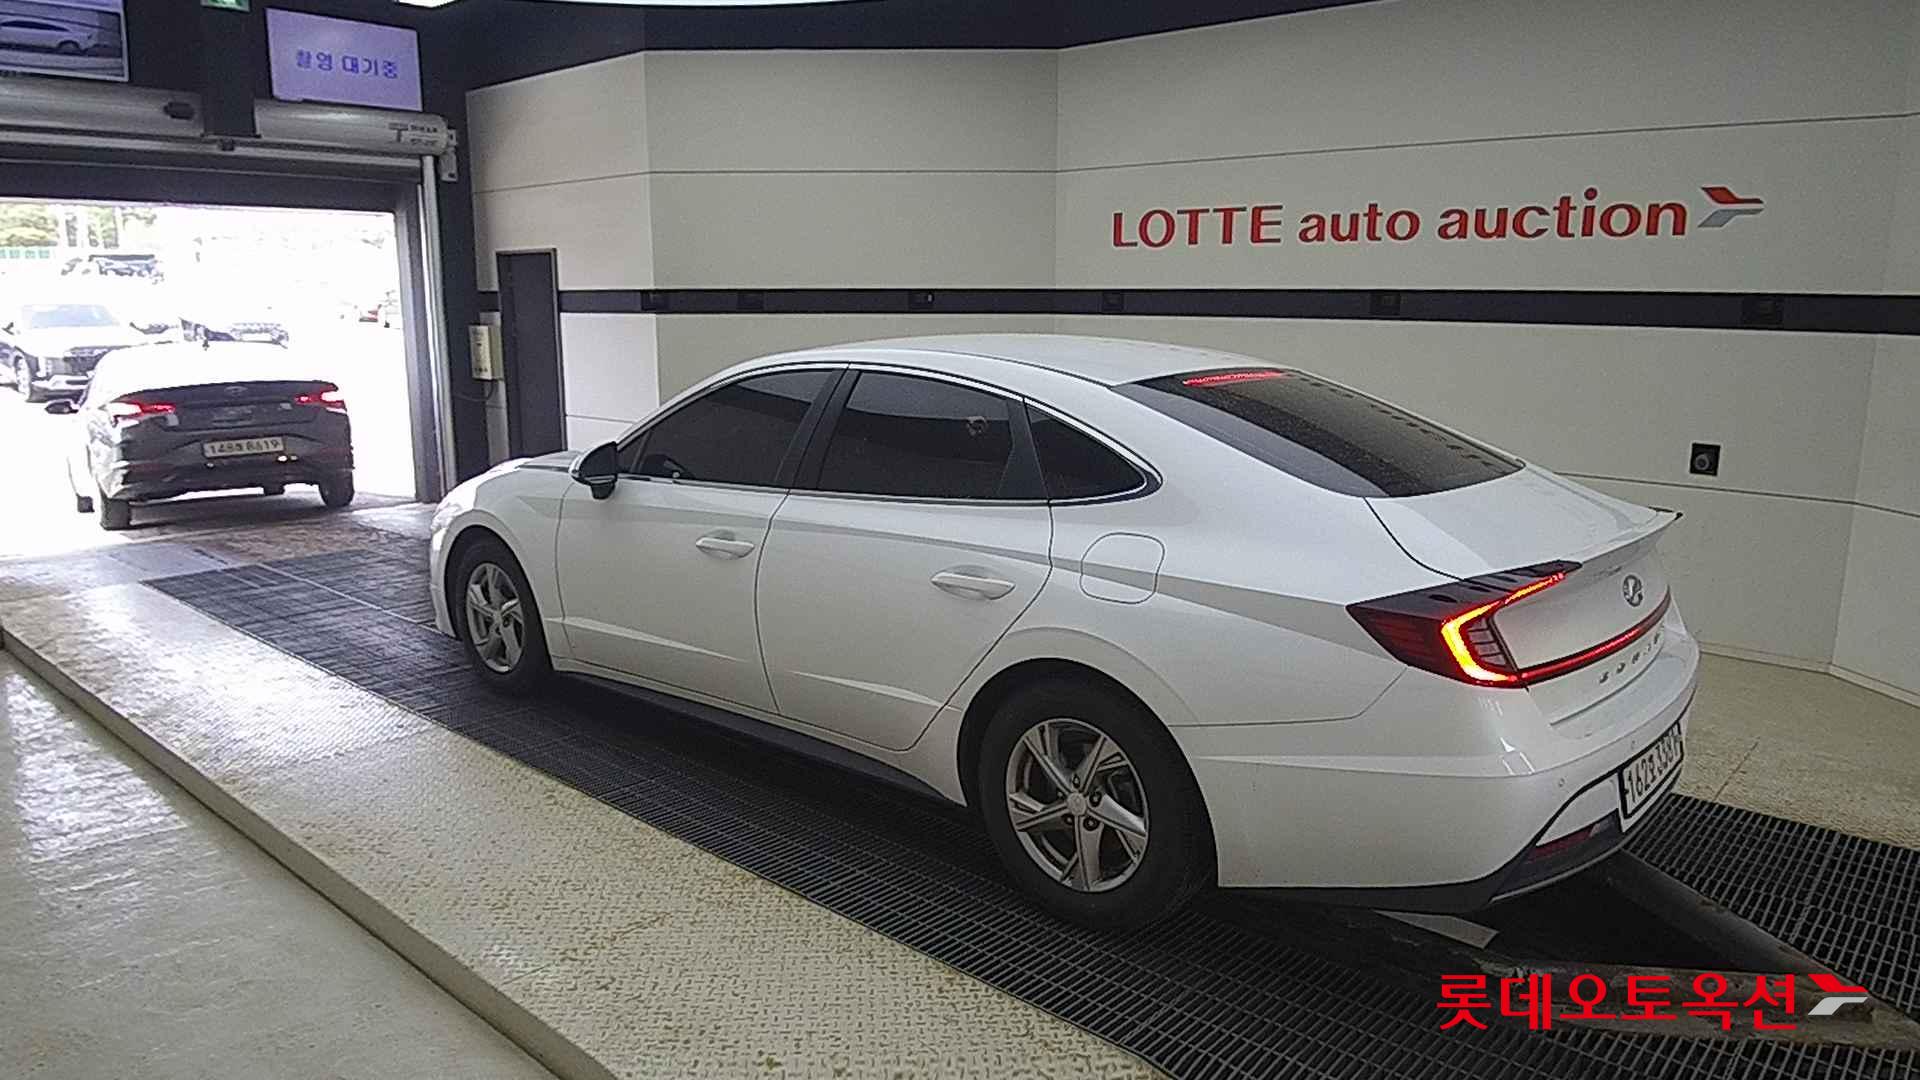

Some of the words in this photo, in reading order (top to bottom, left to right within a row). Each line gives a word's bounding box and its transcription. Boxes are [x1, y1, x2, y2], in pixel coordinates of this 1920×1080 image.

[1113, 205, 1282, 248] LOTTE
[1299, 203, 1421, 242] auto
[1438, 187, 1688, 240] auction
